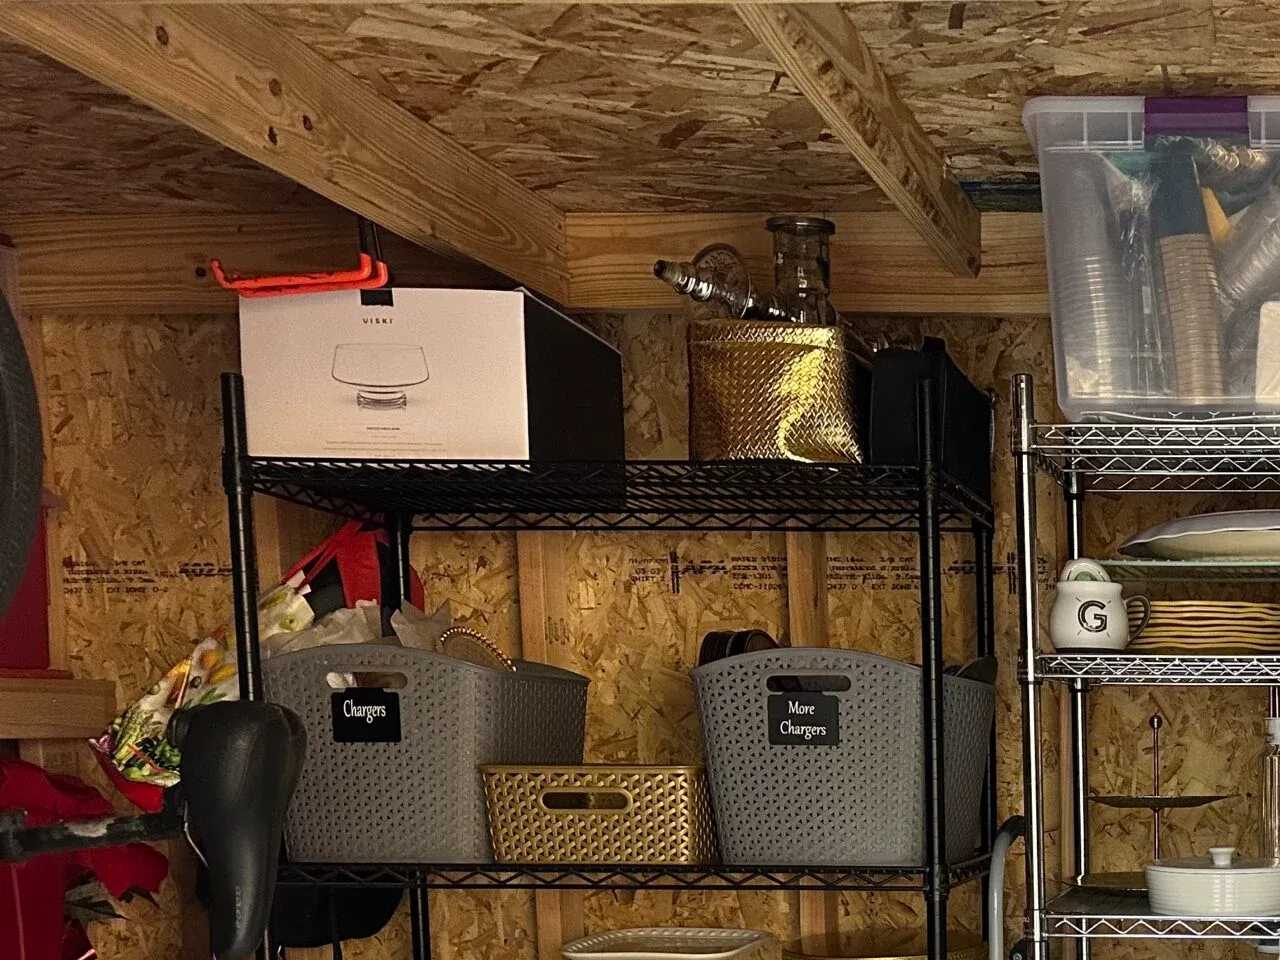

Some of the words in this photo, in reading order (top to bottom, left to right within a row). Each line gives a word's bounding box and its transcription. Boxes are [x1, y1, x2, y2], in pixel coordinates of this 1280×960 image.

[1078, 600, 1107, 632] G
[343, 699, 386, 723] Chargers
[788, 700, 815, 715] More
[780, 720, 827, 740] Chargers
